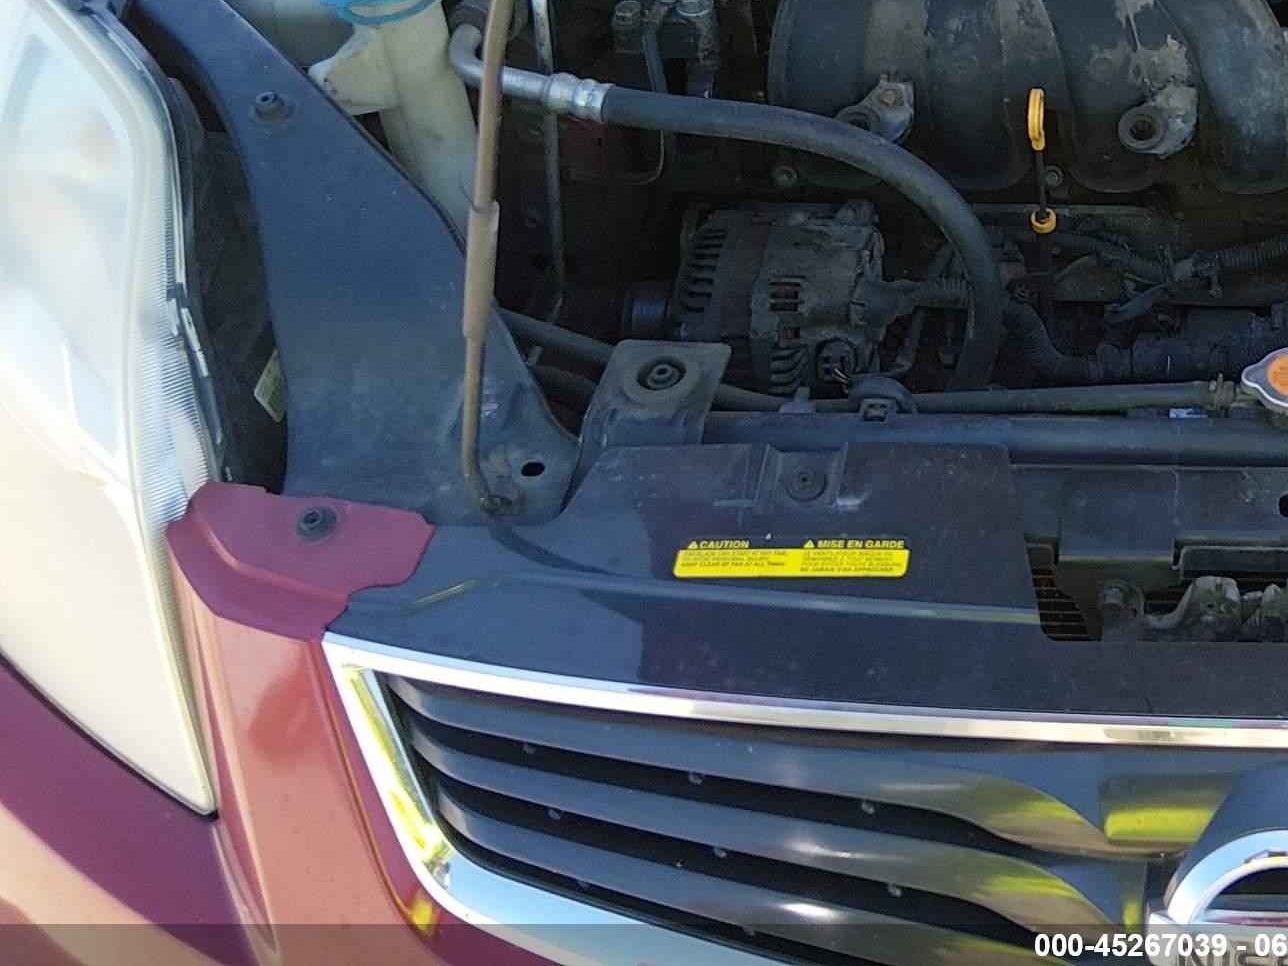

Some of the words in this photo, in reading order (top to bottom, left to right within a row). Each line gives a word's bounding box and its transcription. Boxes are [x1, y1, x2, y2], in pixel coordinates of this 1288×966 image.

[700, 540, 750, 549] CAUTION
[817, 540, 844, 548] MISE
[847, 540, 863, 548] EN
[865, 540, 905, 548] GARDE
